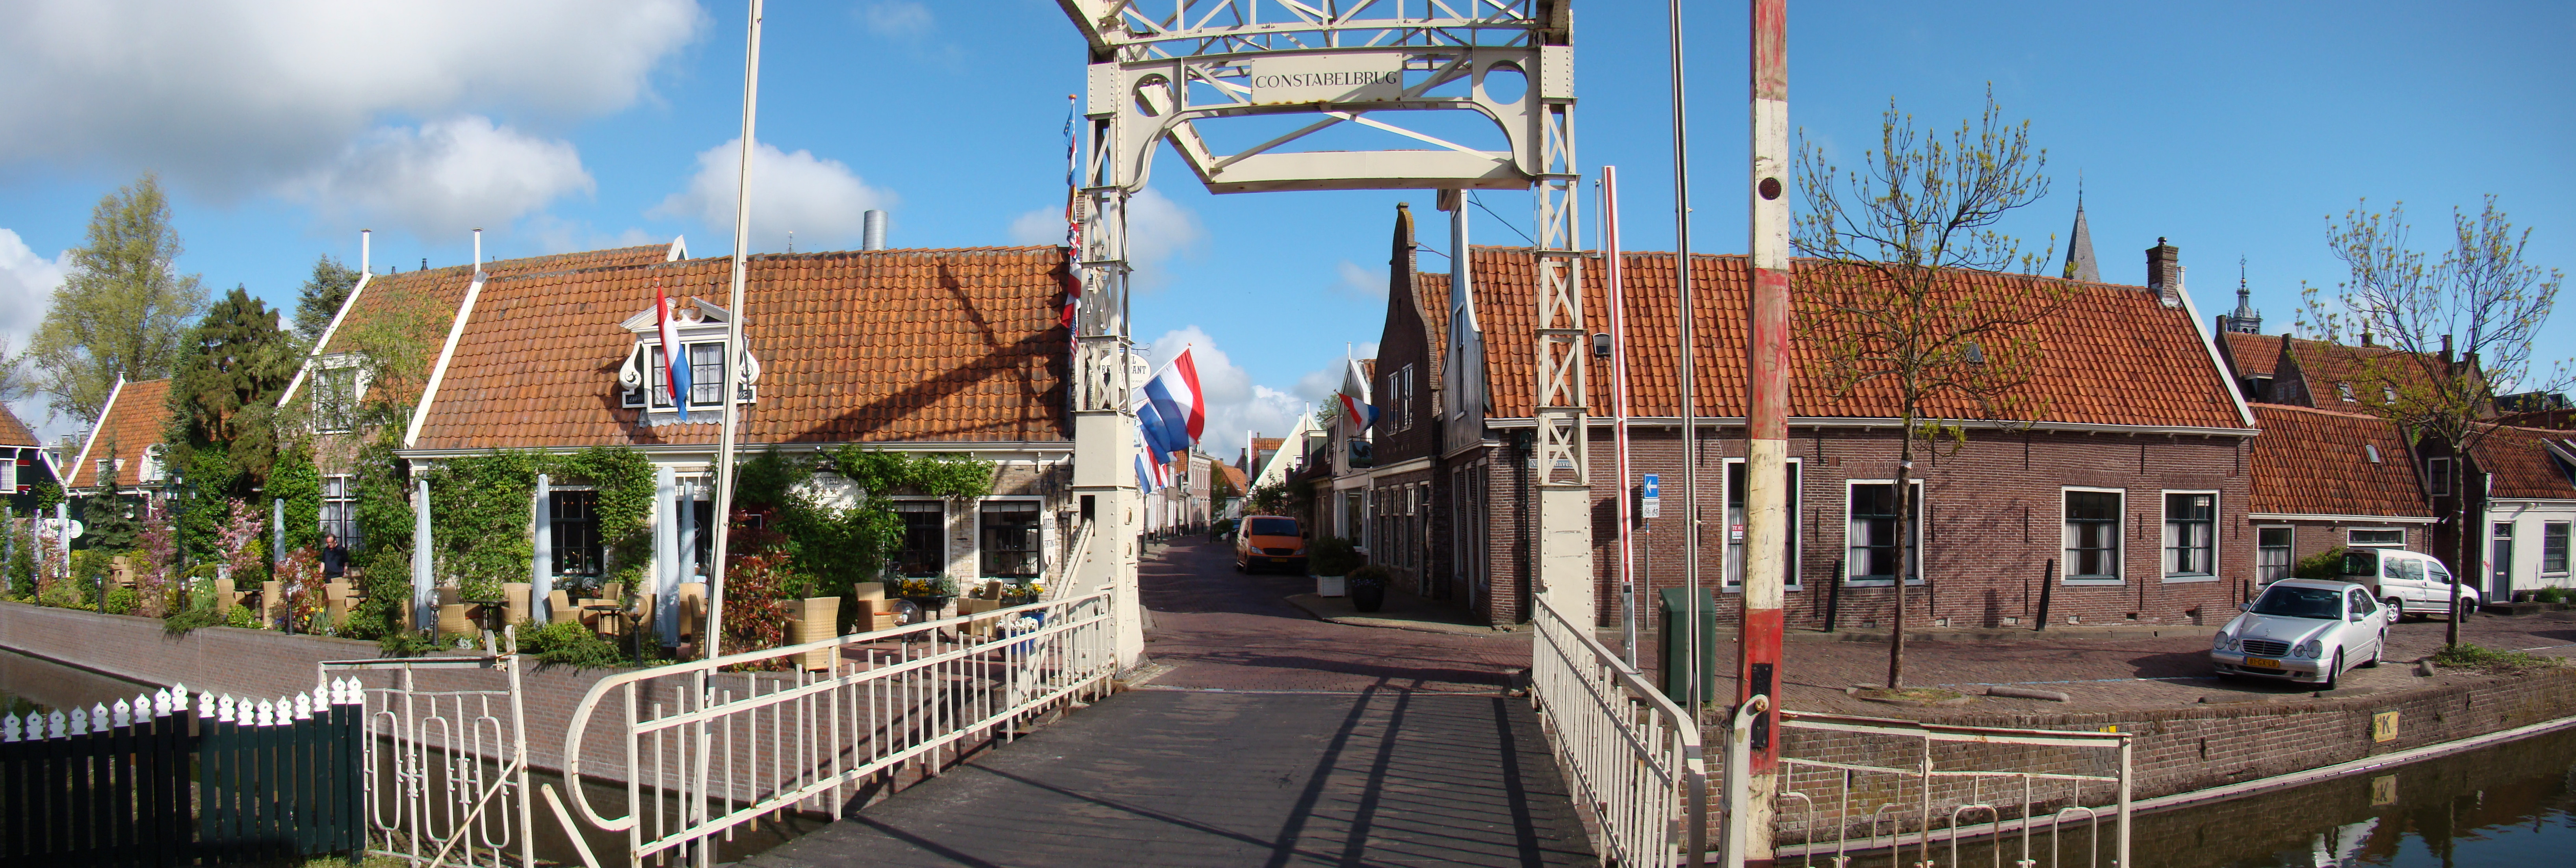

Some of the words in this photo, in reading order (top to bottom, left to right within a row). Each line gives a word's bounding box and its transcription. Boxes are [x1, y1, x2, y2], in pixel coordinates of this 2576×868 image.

[1255, 71, 1397, 88] CONSTABELBRUG
[1044, 518, 1055, 530] HOTEL
[2382, 715, 2391, 734] K
